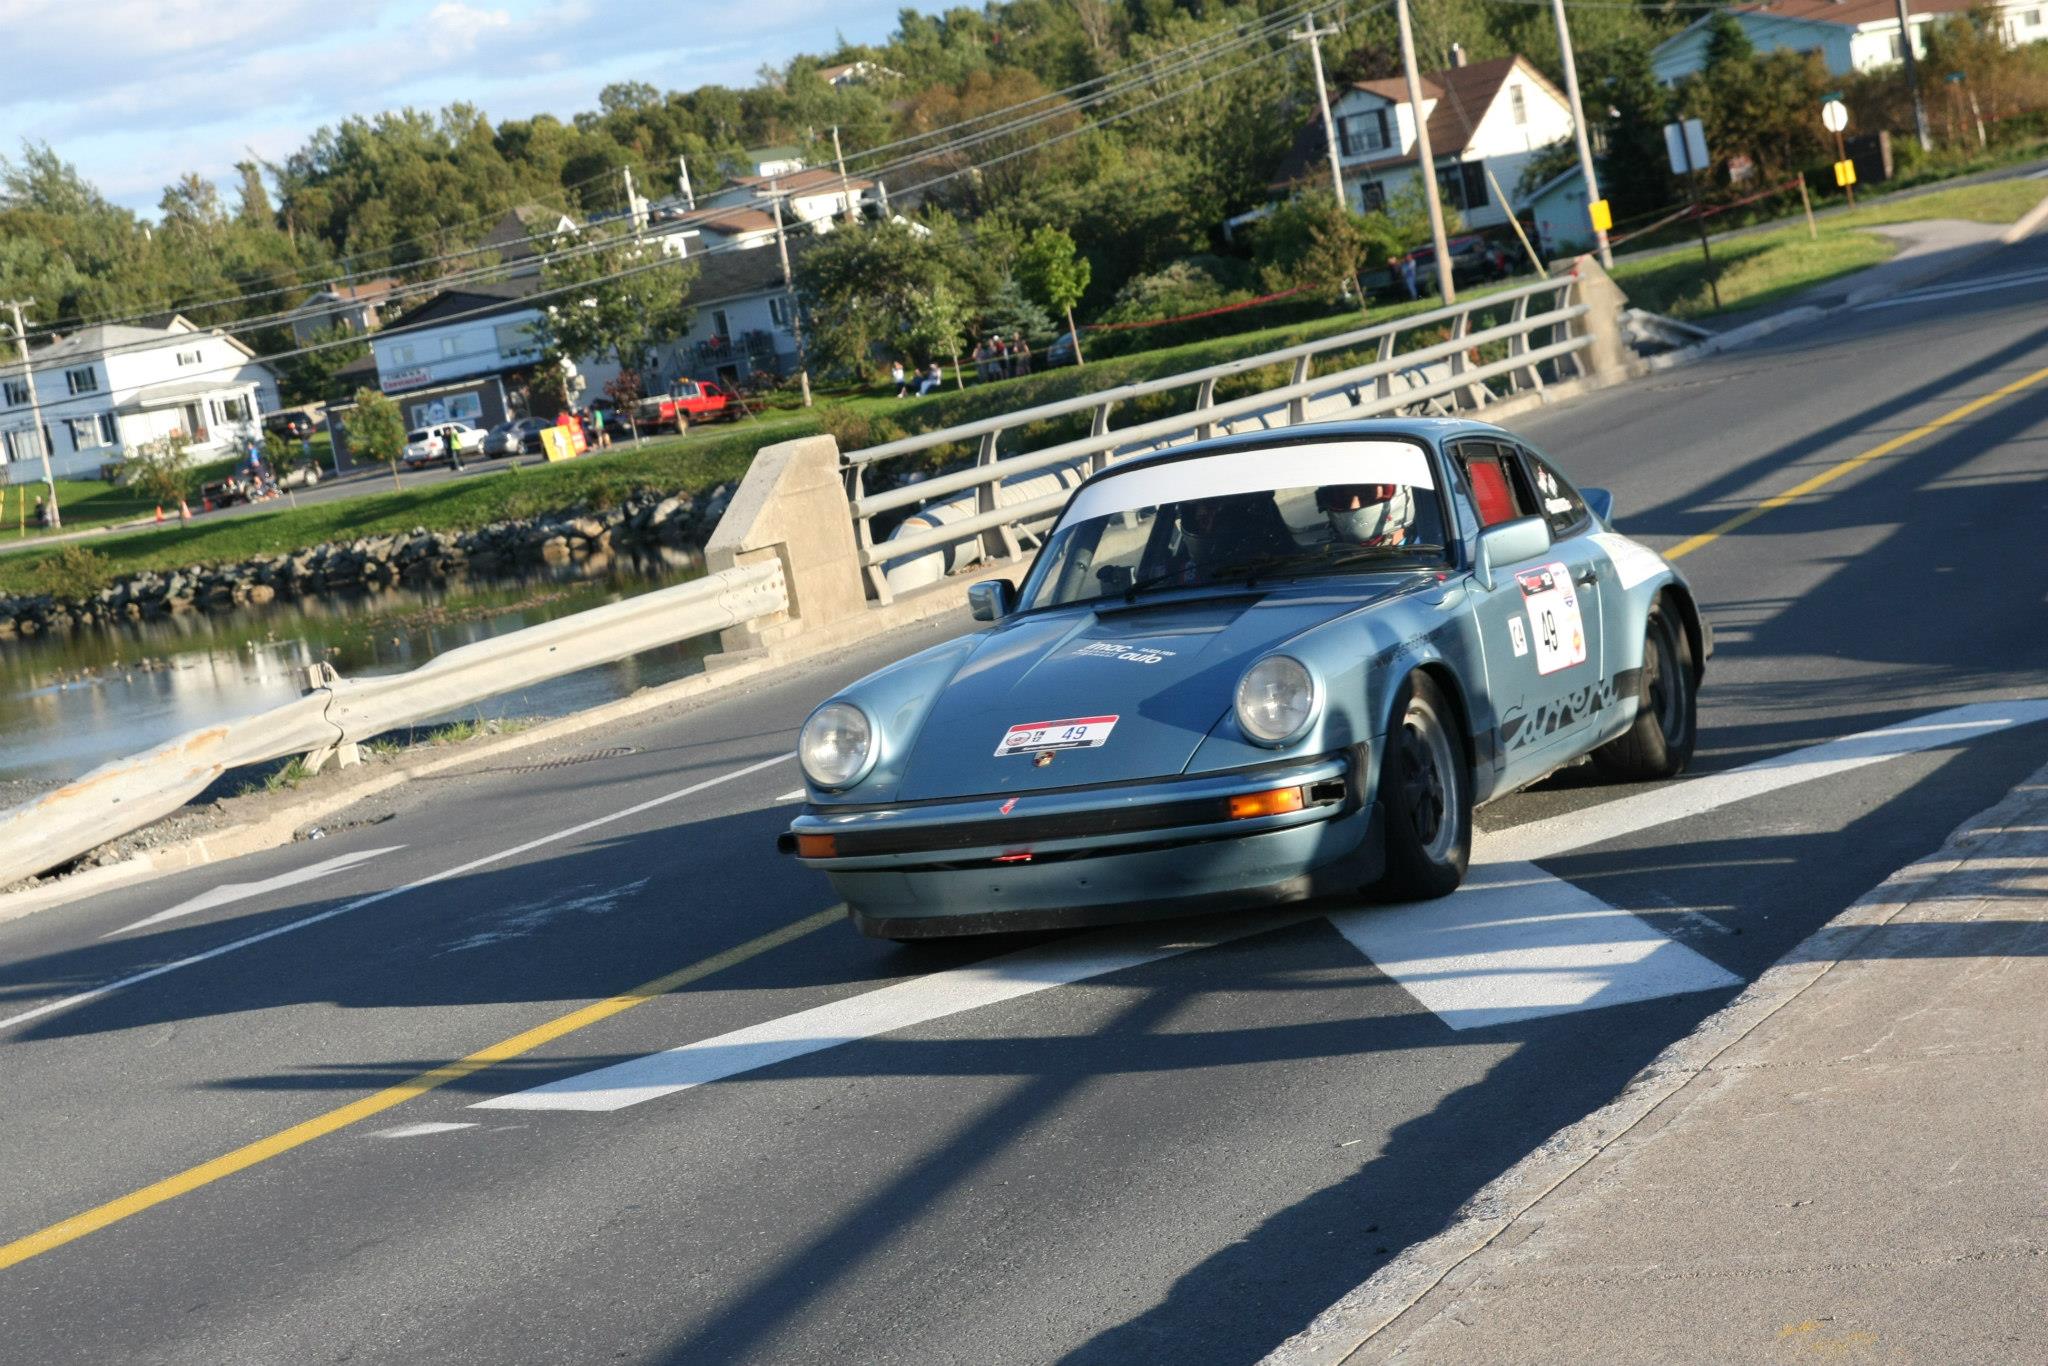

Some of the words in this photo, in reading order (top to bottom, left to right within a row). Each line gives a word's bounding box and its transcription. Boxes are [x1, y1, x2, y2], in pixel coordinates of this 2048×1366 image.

[1541, 609, 1558, 652] 49
[1118, 652, 1162, 664] auto
[1501, 680, 1620, 750] Carrera
[1061, 726, 1088, 740] 49
